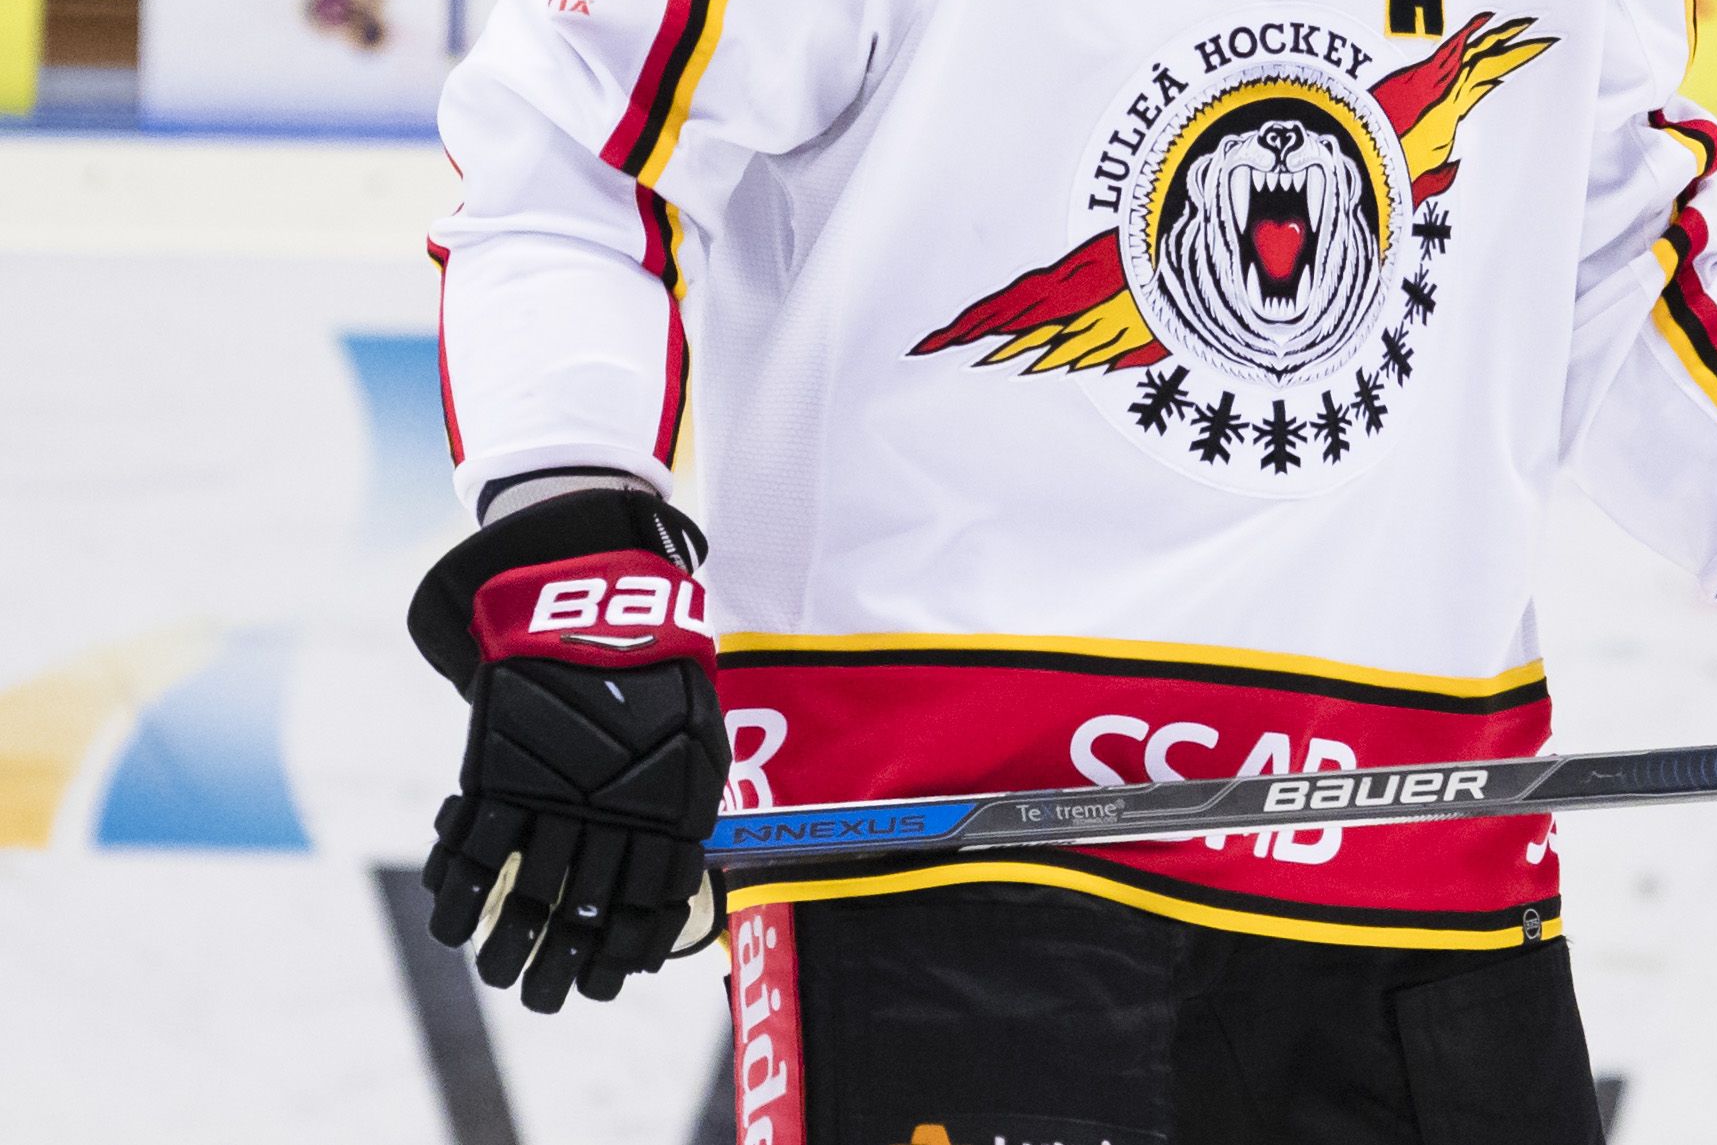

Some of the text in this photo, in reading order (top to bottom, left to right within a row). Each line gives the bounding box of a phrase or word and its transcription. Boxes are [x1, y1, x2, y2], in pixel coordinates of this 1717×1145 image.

[1089, 22, 1373, 214] LULEÅ HOCKEY
[1263, 769, 1489, 813] BAUER
